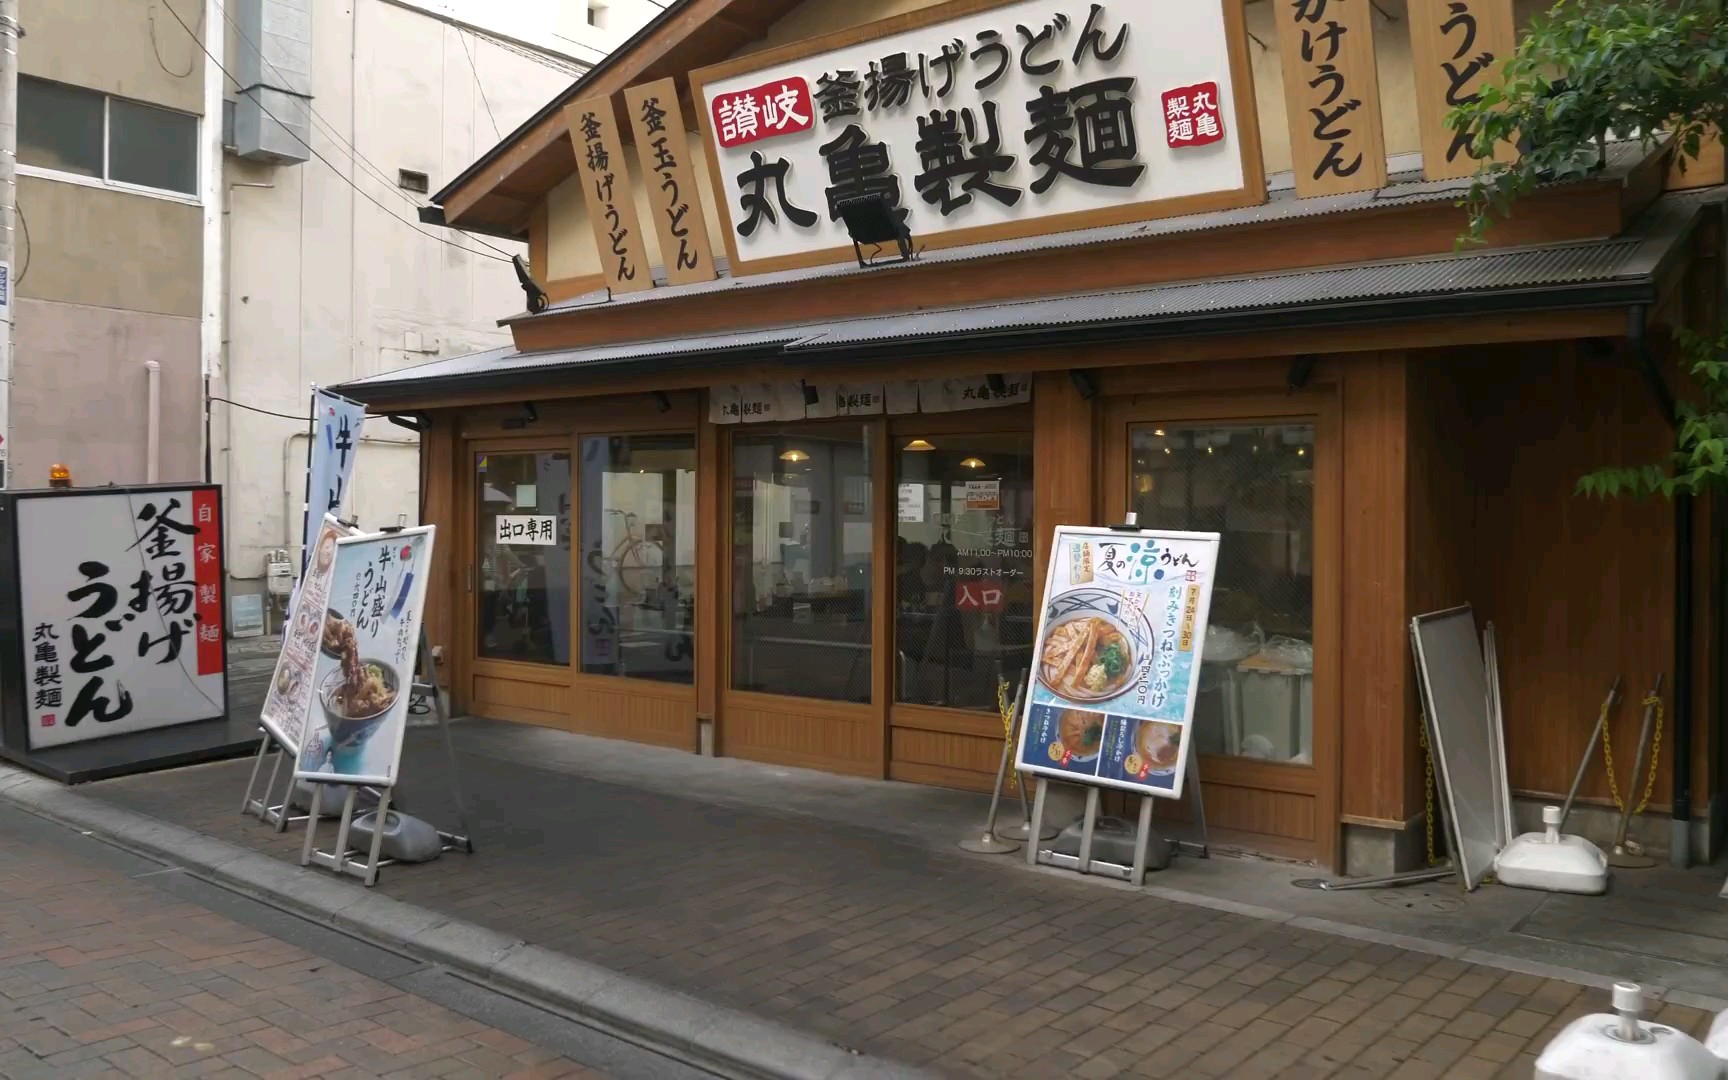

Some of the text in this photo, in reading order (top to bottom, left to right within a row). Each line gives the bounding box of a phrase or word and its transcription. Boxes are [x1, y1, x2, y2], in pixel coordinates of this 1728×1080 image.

[814, 3, 1130, 124] 釜揚げうどん
[578, 112, 636, 284] 釜揚げうどん
[640, 97, 698, 272] 釜玉うどん
[736, 77, 1147, 238] 丸亀製麺
[125, 498, 202, 665] 釜揚げ
[198, 504, 220, 643] 自家製麺
[499, 517, 553, 542] 出口専用
[65, 560, 136, 728] うどん
[356, 561, 374, 630] うどん
[957, 585, 1002, 607] 入口
[1151, 585, 1183, 708] 刻みきつねぶっかけ
[32, 622, 63, 710] 丸亀製麺
